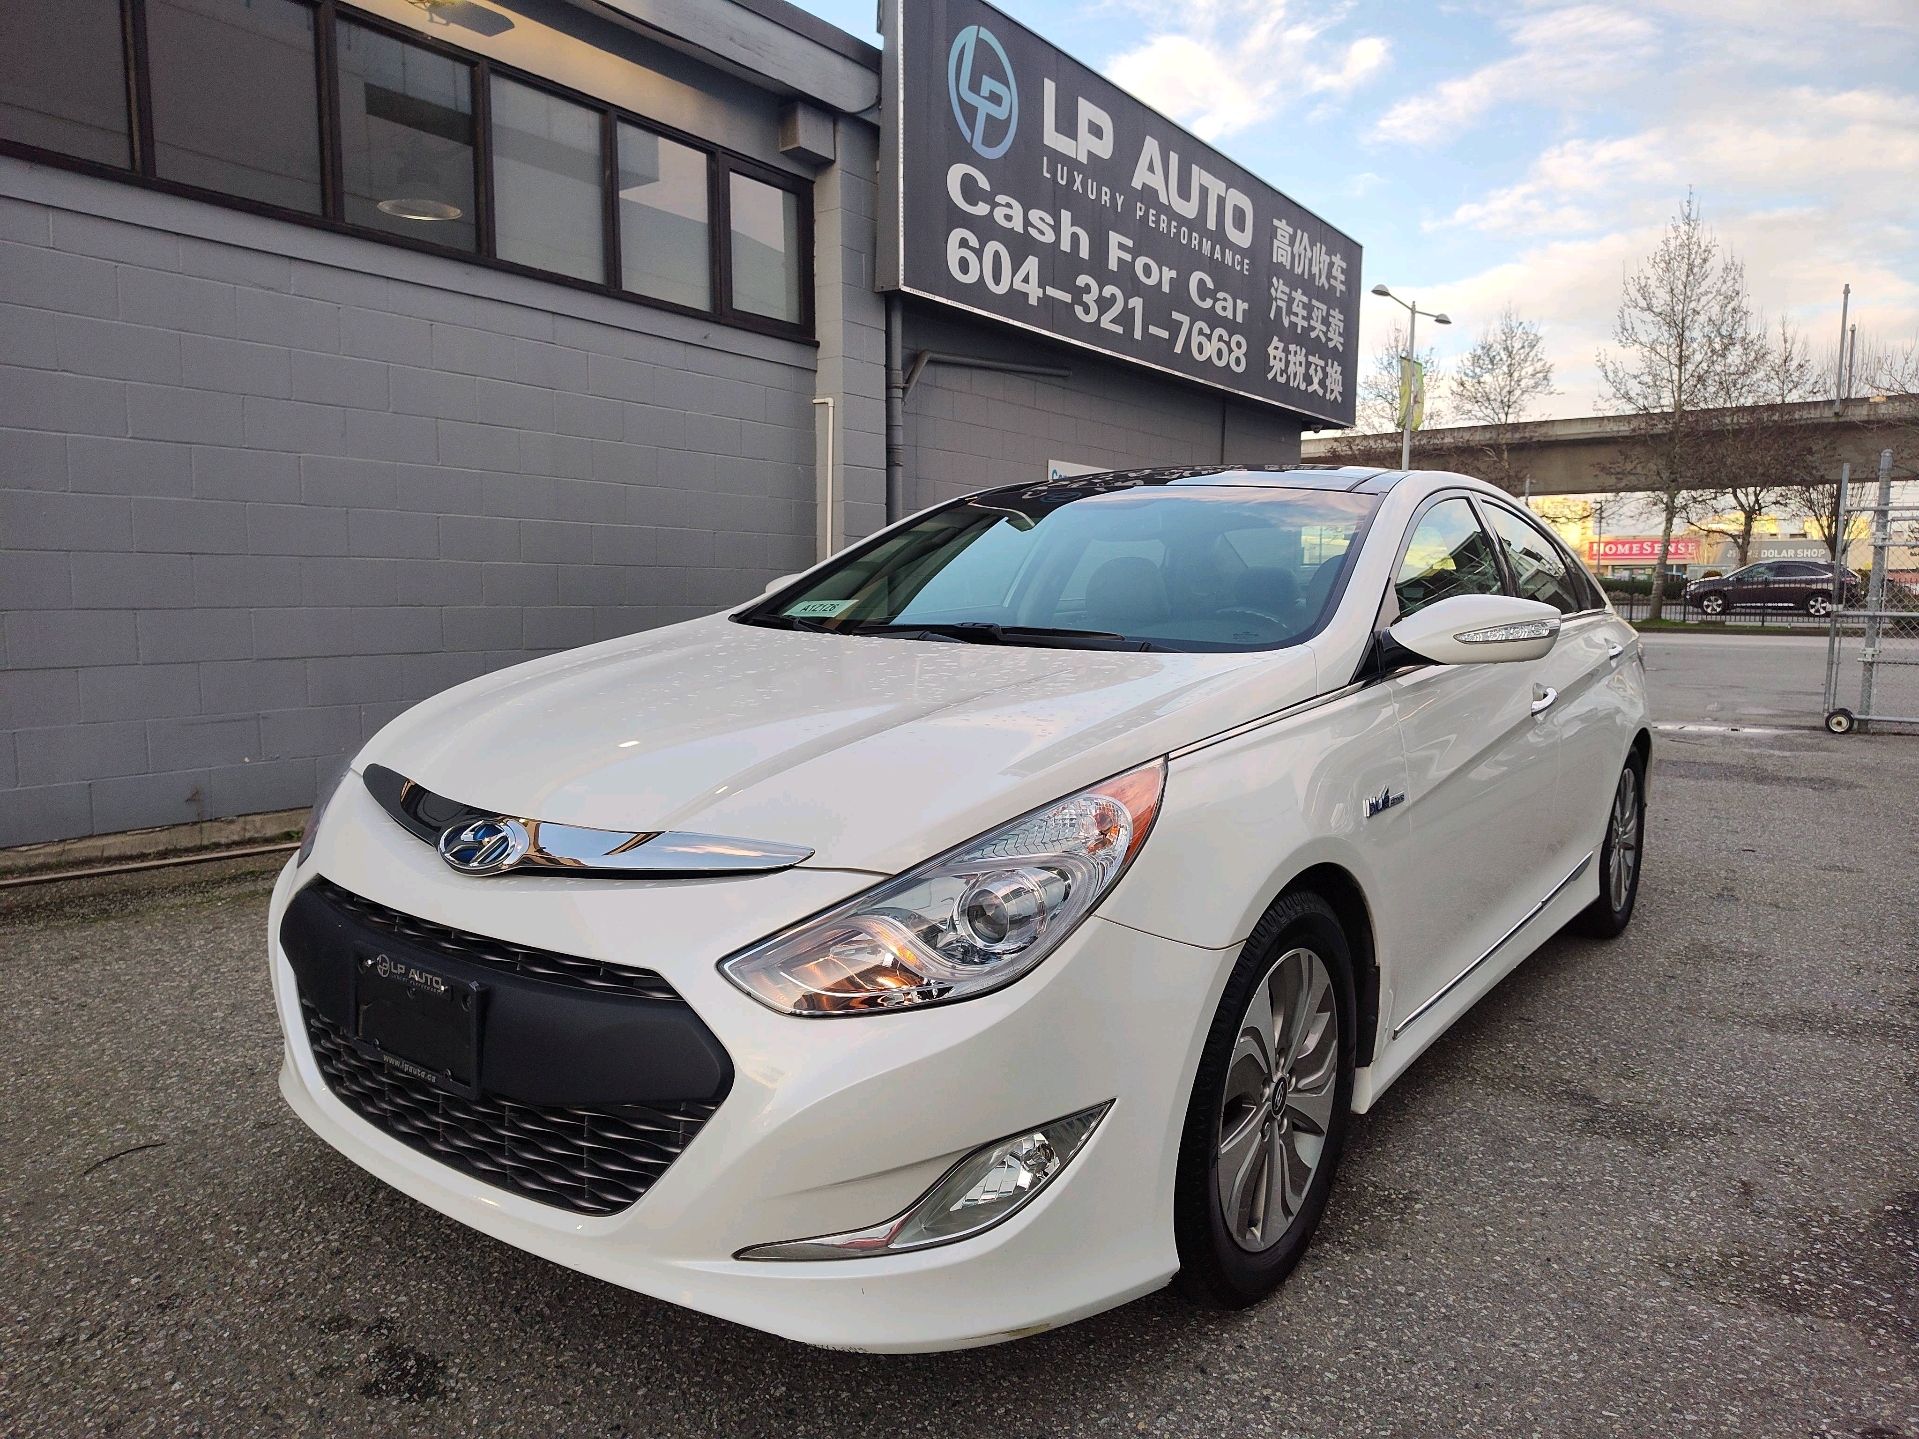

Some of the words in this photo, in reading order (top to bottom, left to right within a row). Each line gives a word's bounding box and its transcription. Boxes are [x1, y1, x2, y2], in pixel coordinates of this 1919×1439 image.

[1043, 77, 1114, 164] LP
[1131, 135, 1254, 249] AUTO
[946, 163, 1090, 260] Cash
[1108, 230, 1177, 294] For
[1188, 270, 1249, 324] Car
[1043, 156, 1125, 212] LUXURY
[1136, 202, 1250, 275] PERFORMANCE
[1272, 218, 1348, 298] 高价收车
[946, 228, 1248, 373] 604-321-7668
[1269, 276, 1345, 353] 汽车买卖
[1266, 335, 1344, 404] 免税交换
[1760, 549, 1795, 558] DOLAR
[1796, 548, 1826, 558] SHOP
[390, 961, 406, 975] LP
[408, 968, 443, 989] AUTO
